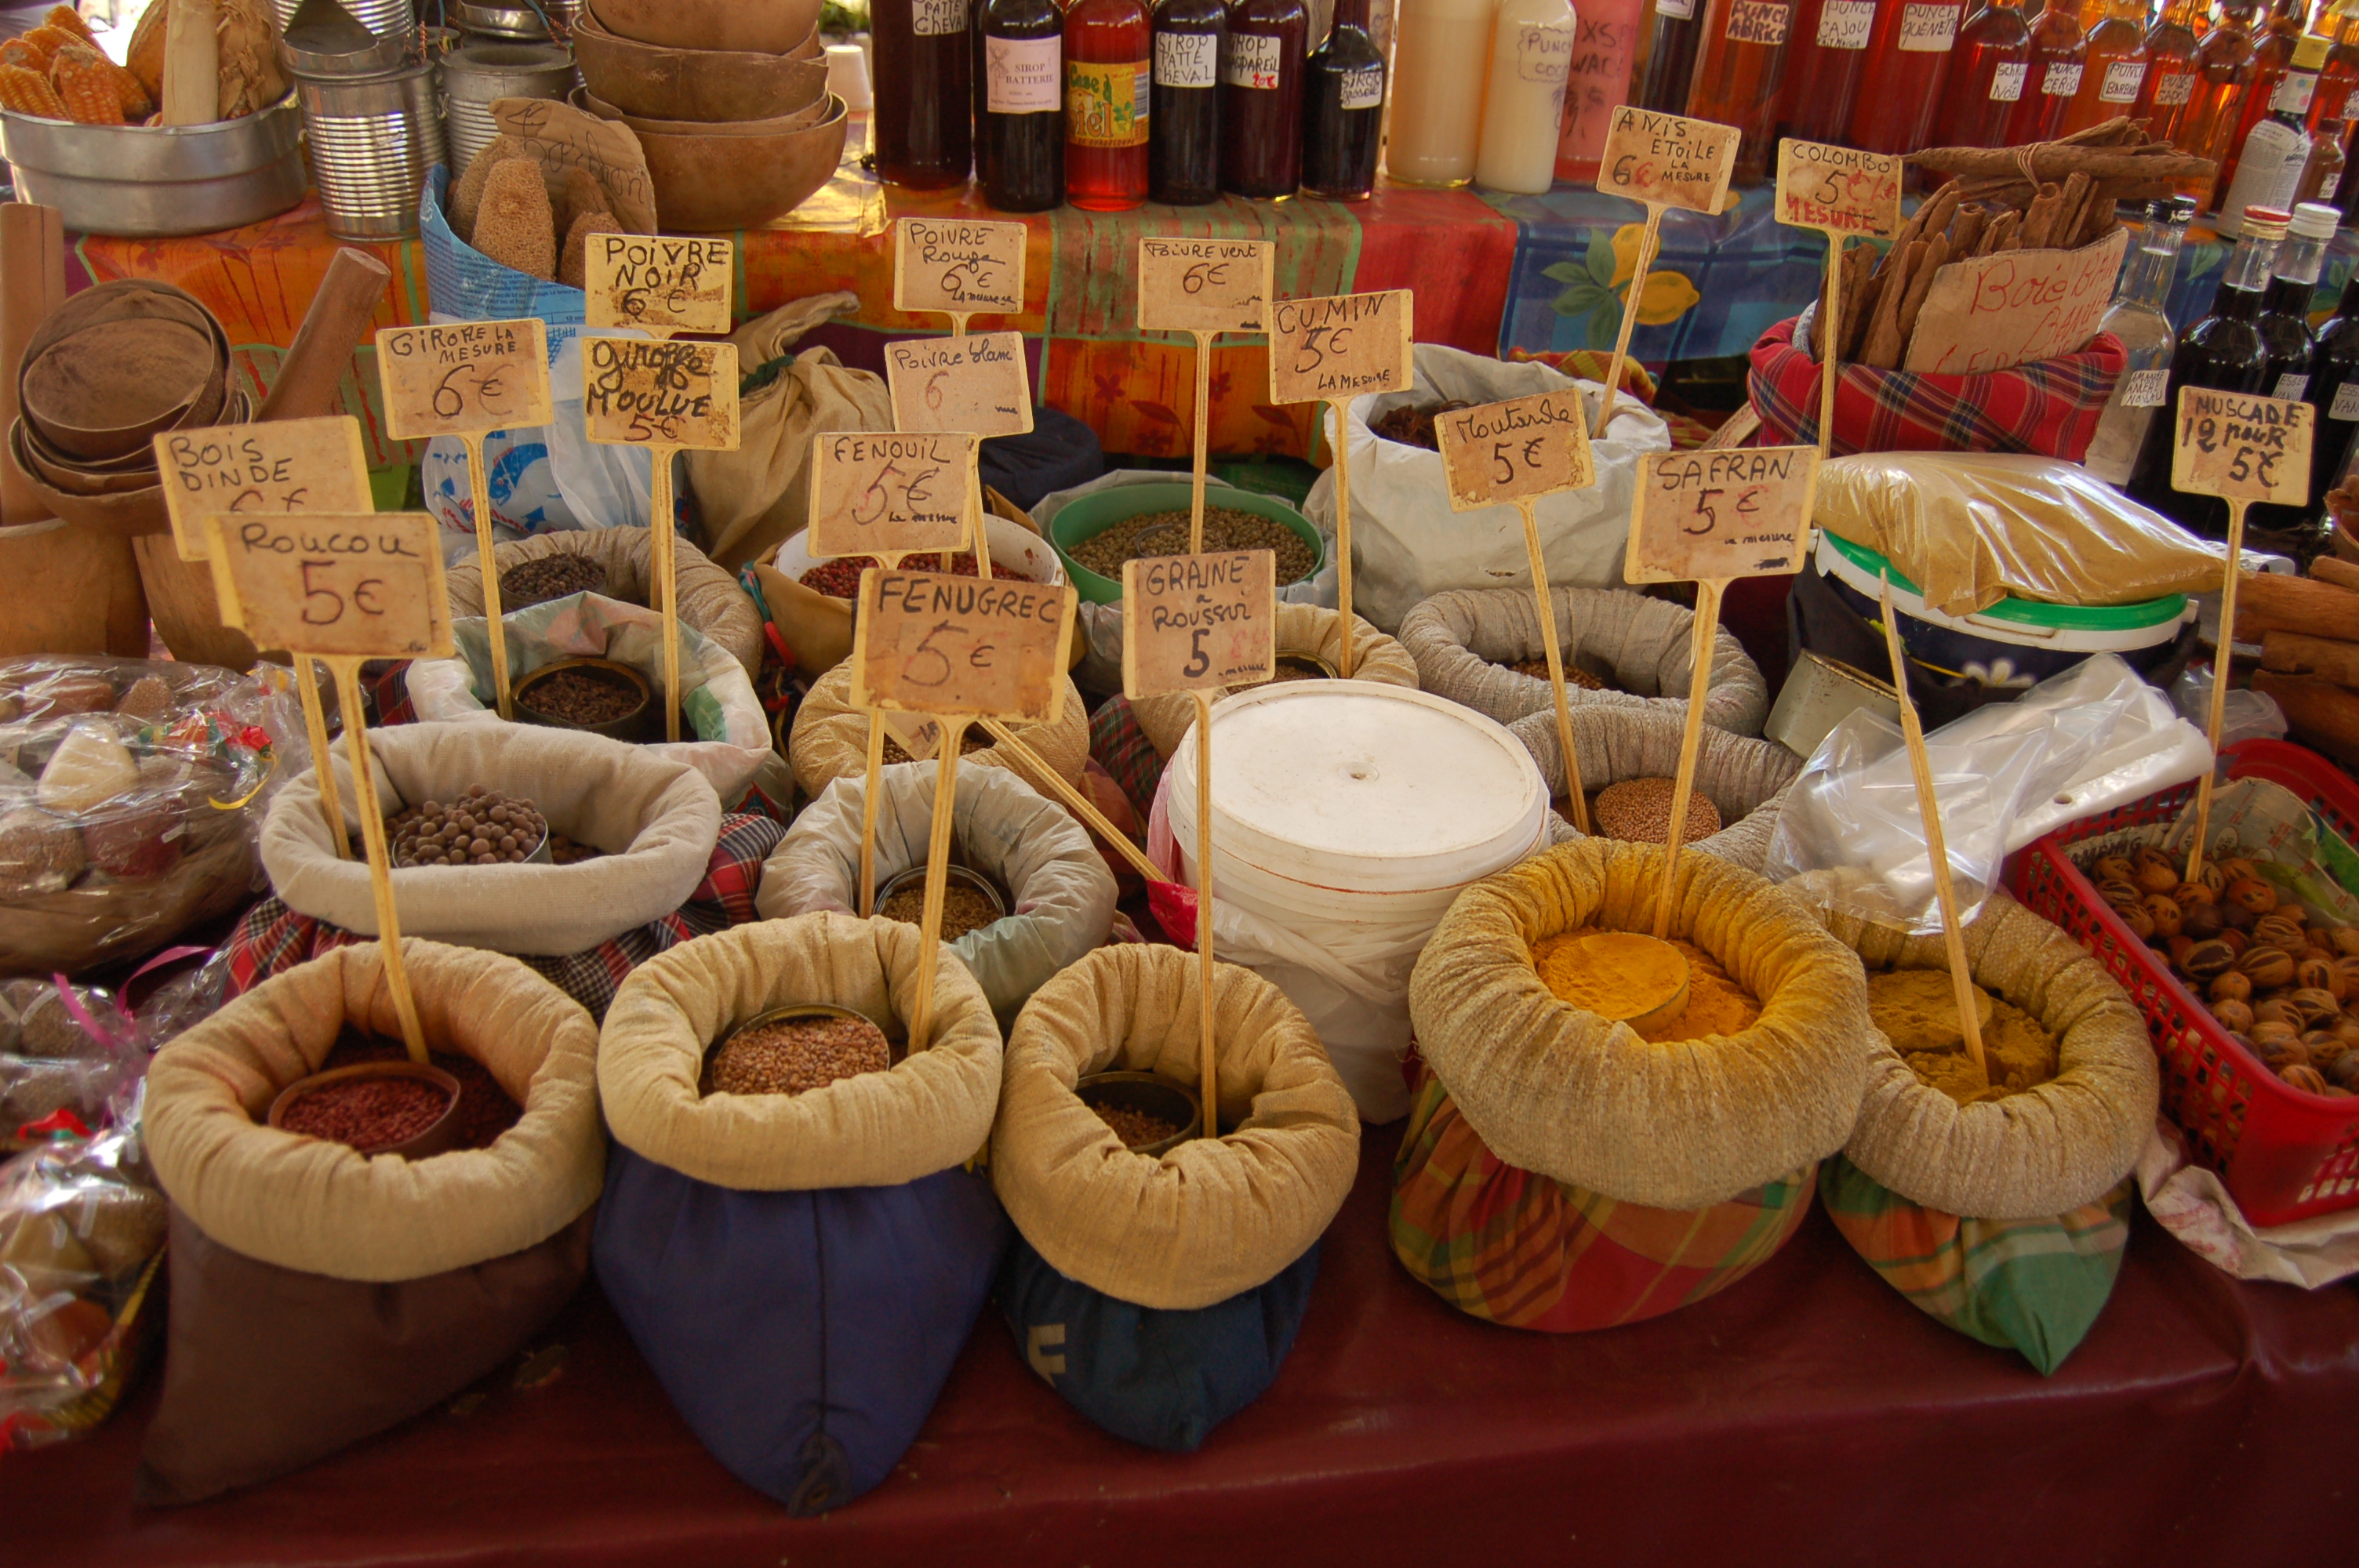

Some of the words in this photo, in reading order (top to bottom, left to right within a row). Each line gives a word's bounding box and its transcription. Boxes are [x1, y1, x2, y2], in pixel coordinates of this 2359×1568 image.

[1015, 64, 1045, 72] SIROP
[1670, 159, 1689, 170] LA
[1793, 143, 1891, 173] COLOMBO
[1661, 170, 1711, 183] MESURE
[496, 326, 514, 339] LA
[439, 341, 516, 365] MESURE
[2195, 395, 2304, 428] MUSCADE
[178, 458, 293, 492] DINDE
[1656, 451, 1794, 491] SAFRAN
[1146, 555, 1250, 596] GRAINE
[878, 577, 1056, 623] FENUGREC
